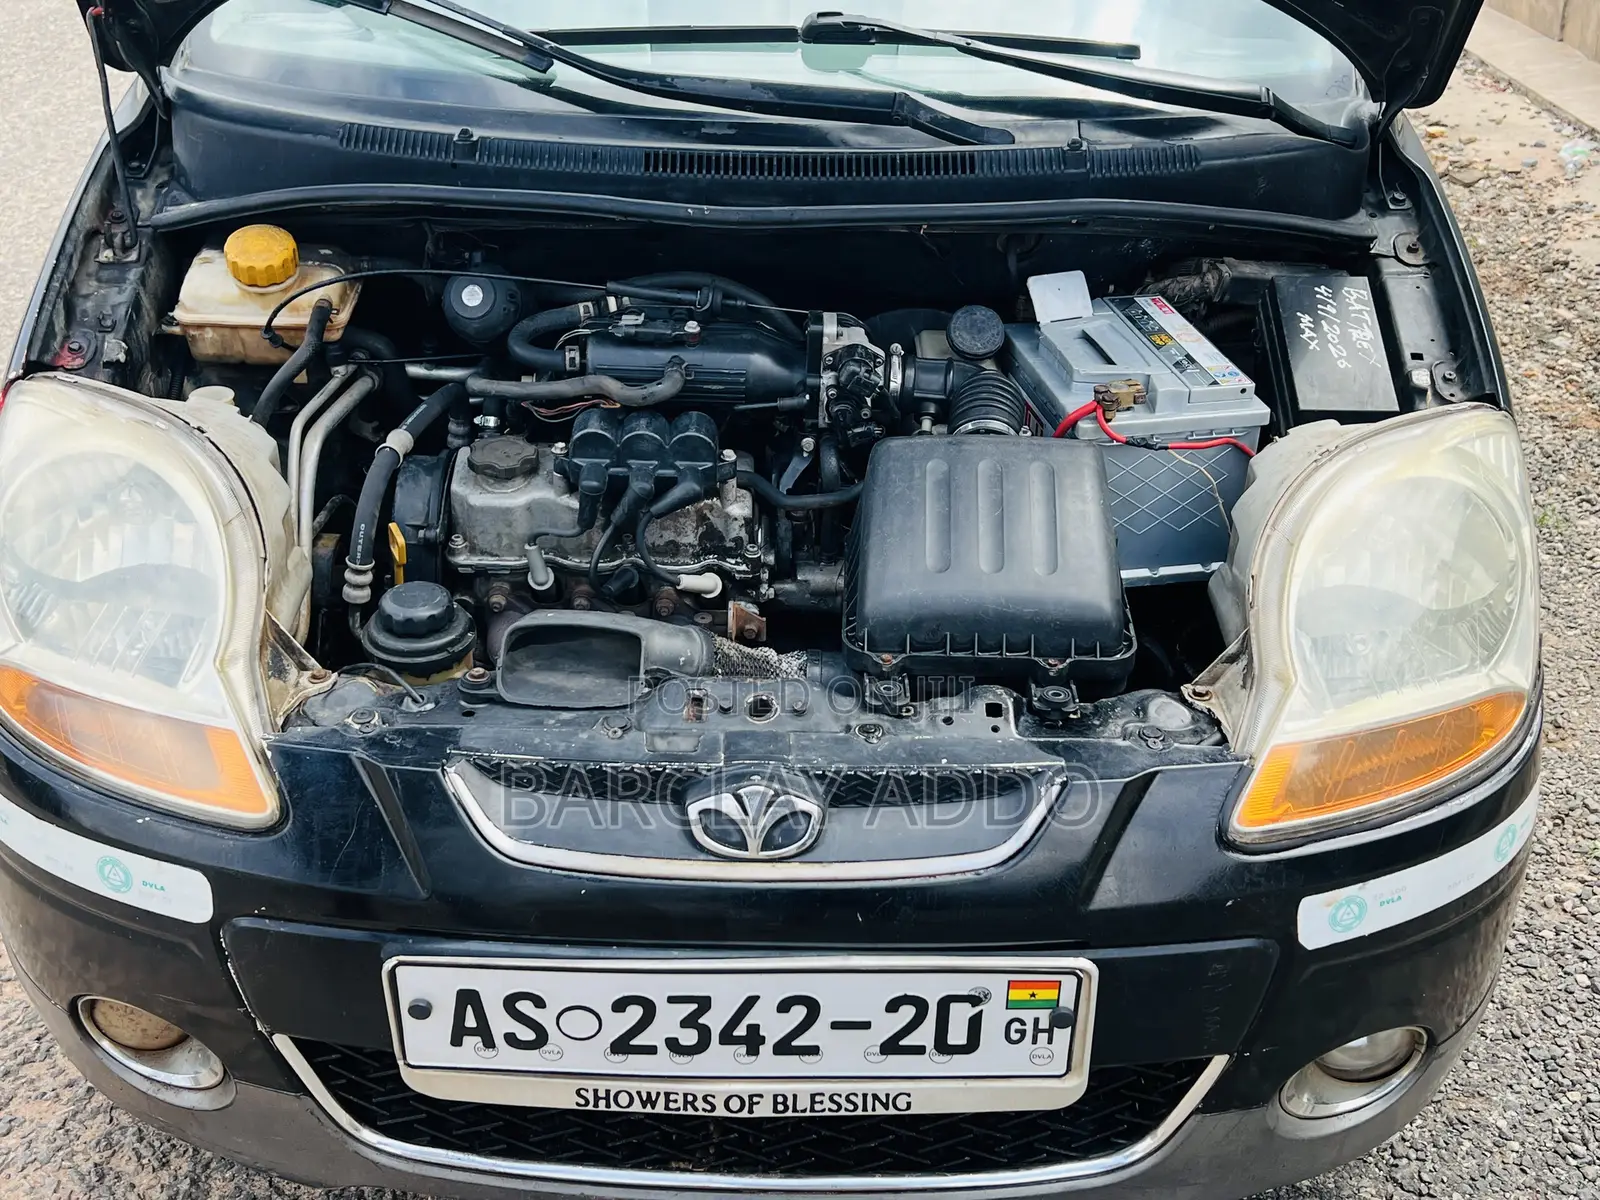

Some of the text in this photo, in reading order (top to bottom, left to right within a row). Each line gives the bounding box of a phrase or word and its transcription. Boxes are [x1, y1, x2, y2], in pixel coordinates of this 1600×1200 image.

[1296, 311, 1320, 351] MAX
[449, 988, 984, 1056] AS 2342-20
[1004, 1016, 1055, 1045] GH
[575, 1087, 913, 1115] SHOWERS OF BLESSING
